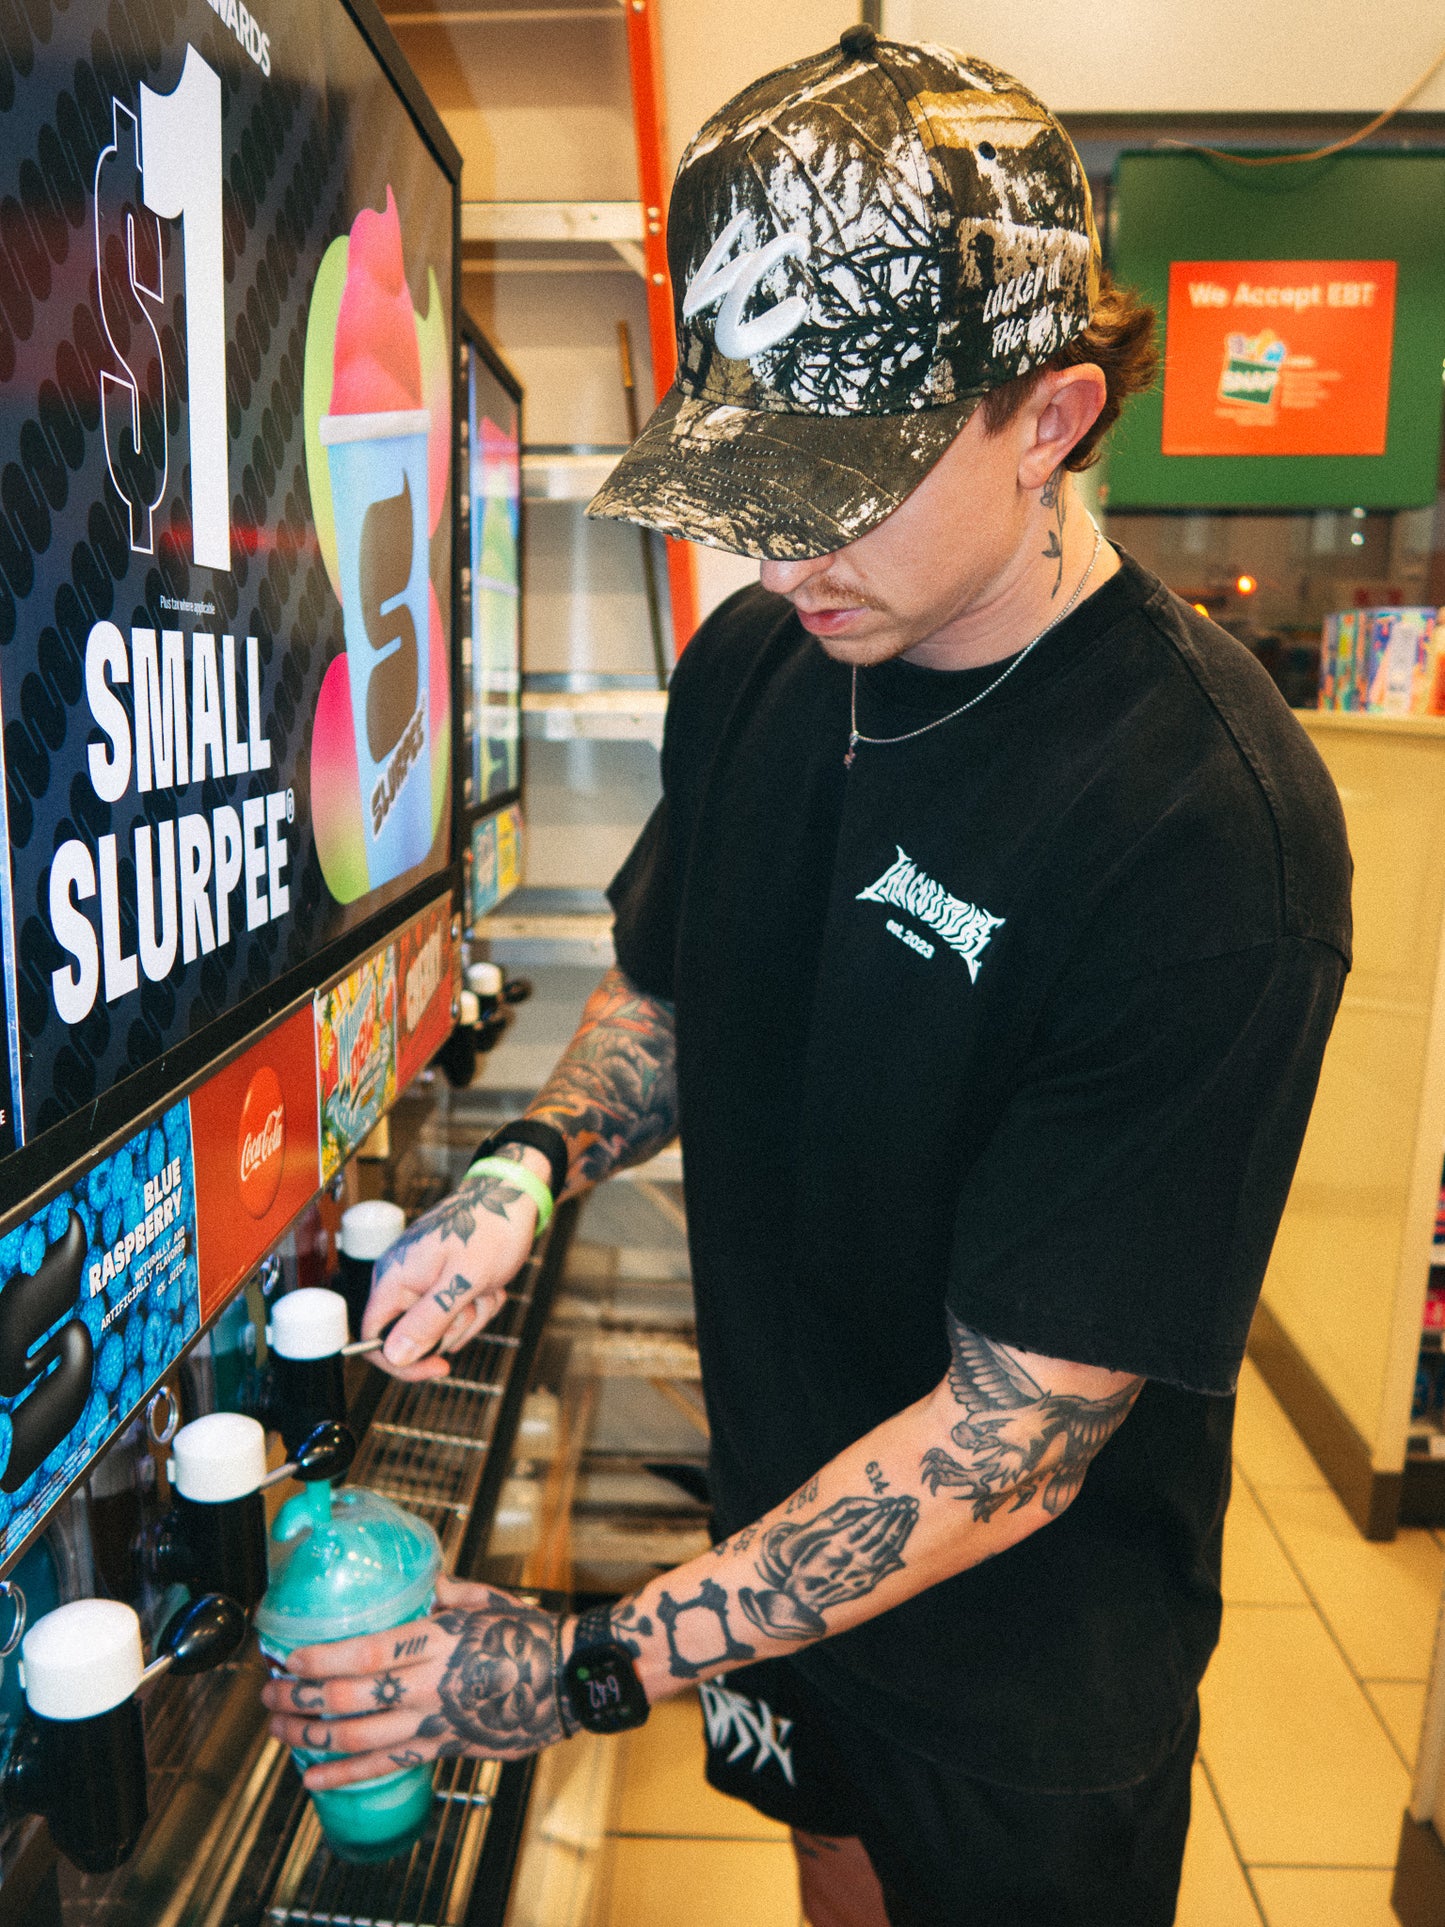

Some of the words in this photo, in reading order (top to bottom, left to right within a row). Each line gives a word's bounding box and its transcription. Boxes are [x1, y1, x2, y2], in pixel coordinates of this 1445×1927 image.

[982, 266, 1045, 323] LOCKED
[1188, 282, 1230, 308] We
[1233, 282, 1322, 314] Accept
[85, 620, 271, 802] SMALL
[902, 930, 935, 959] 2023
[144, 1156, 181, 1213] BLUE
[89, 1186, 183, 1298] RASPBERRY
[135, 1238, 171, 1282] NATURALLY
[174, 1225, 185, 1243] AND
[100, 1271, 153, 1332] ARTIFICIALLY
[155, 1237, 186, 1275] FLAVORED
[168, 1258, 187, 1285] JUICE
